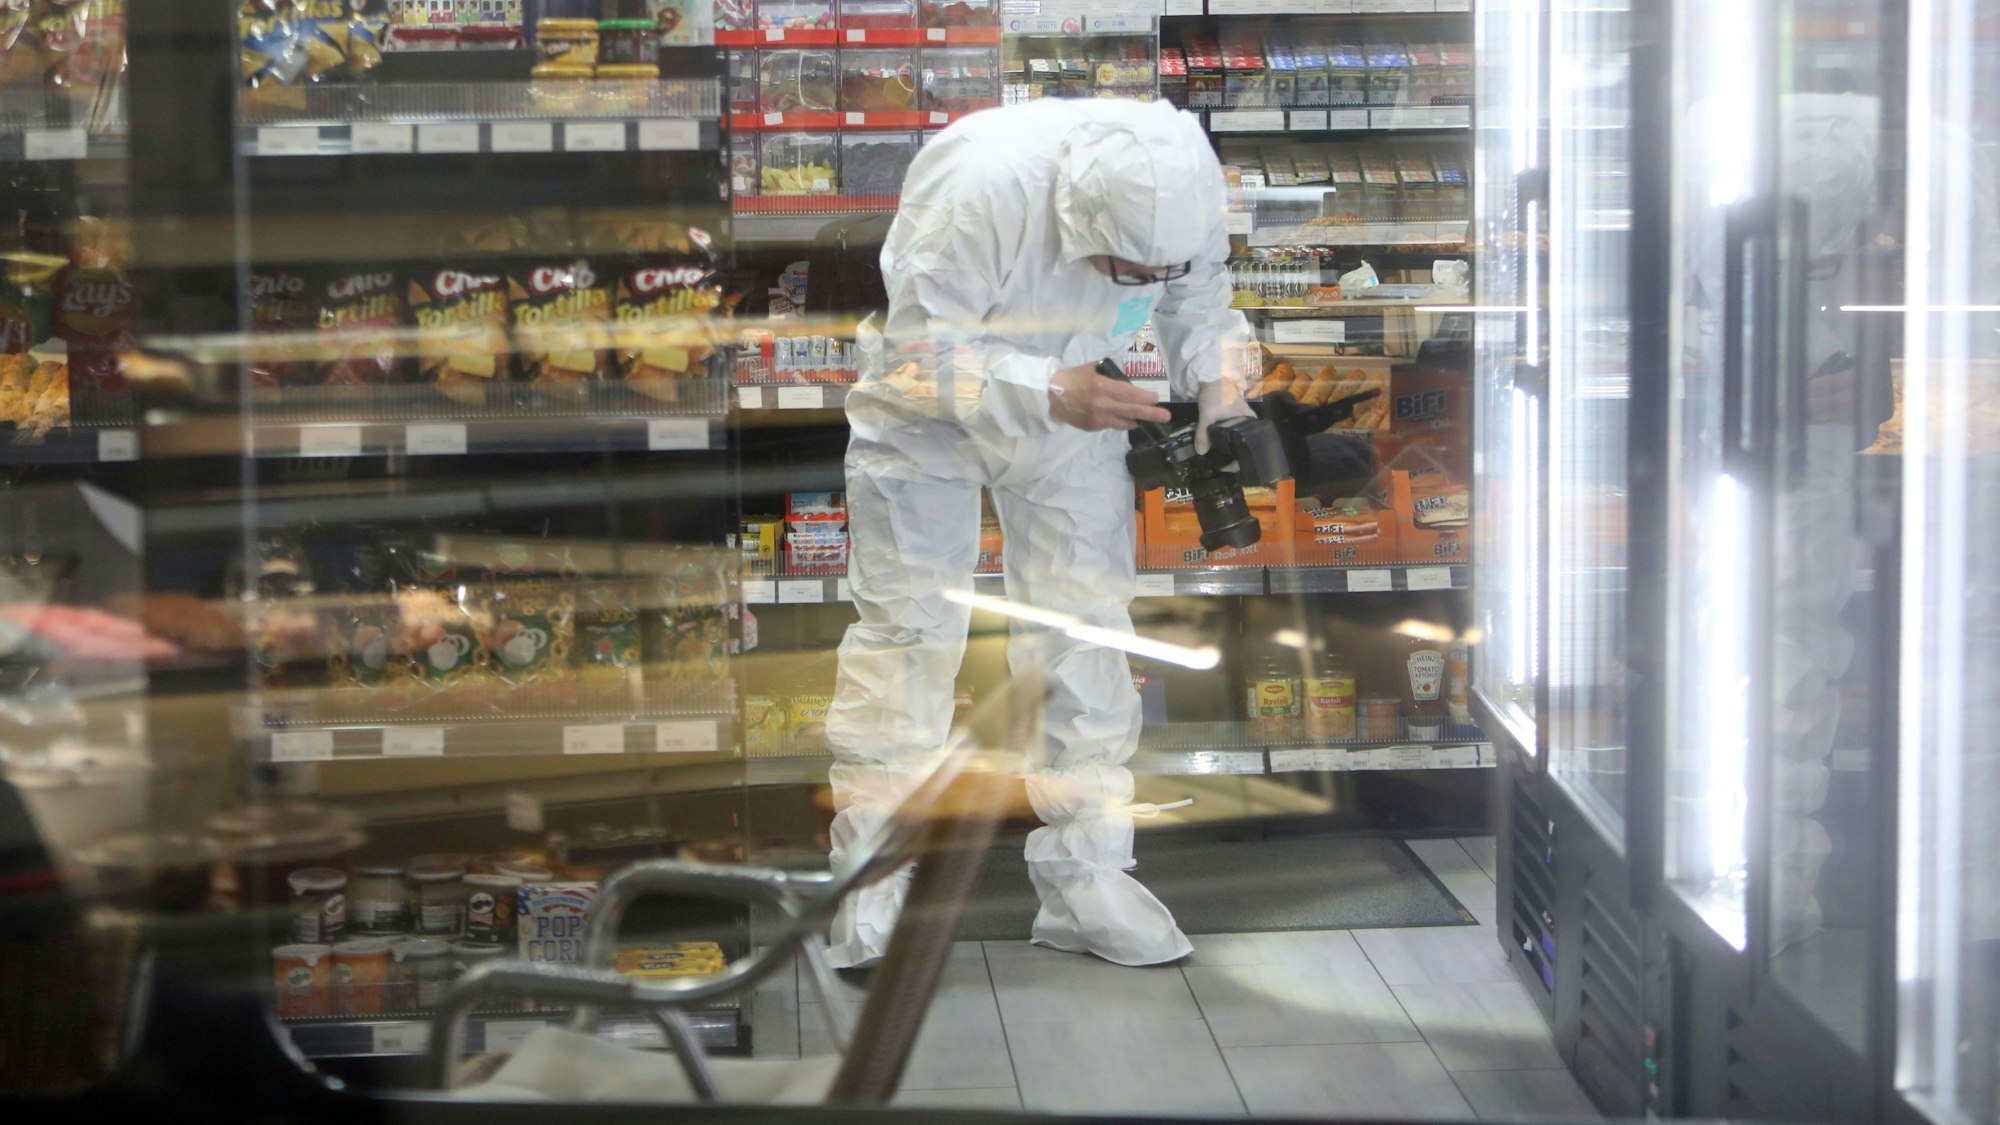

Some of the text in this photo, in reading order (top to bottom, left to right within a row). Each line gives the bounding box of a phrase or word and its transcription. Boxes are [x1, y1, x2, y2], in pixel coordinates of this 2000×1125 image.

[635, 268, 705, 292] Chio
[1396, 389, 1446, 419] BiFi
[1263, 697, 1289, 706] Ravioli
[535, 916, 581, 938] POP
